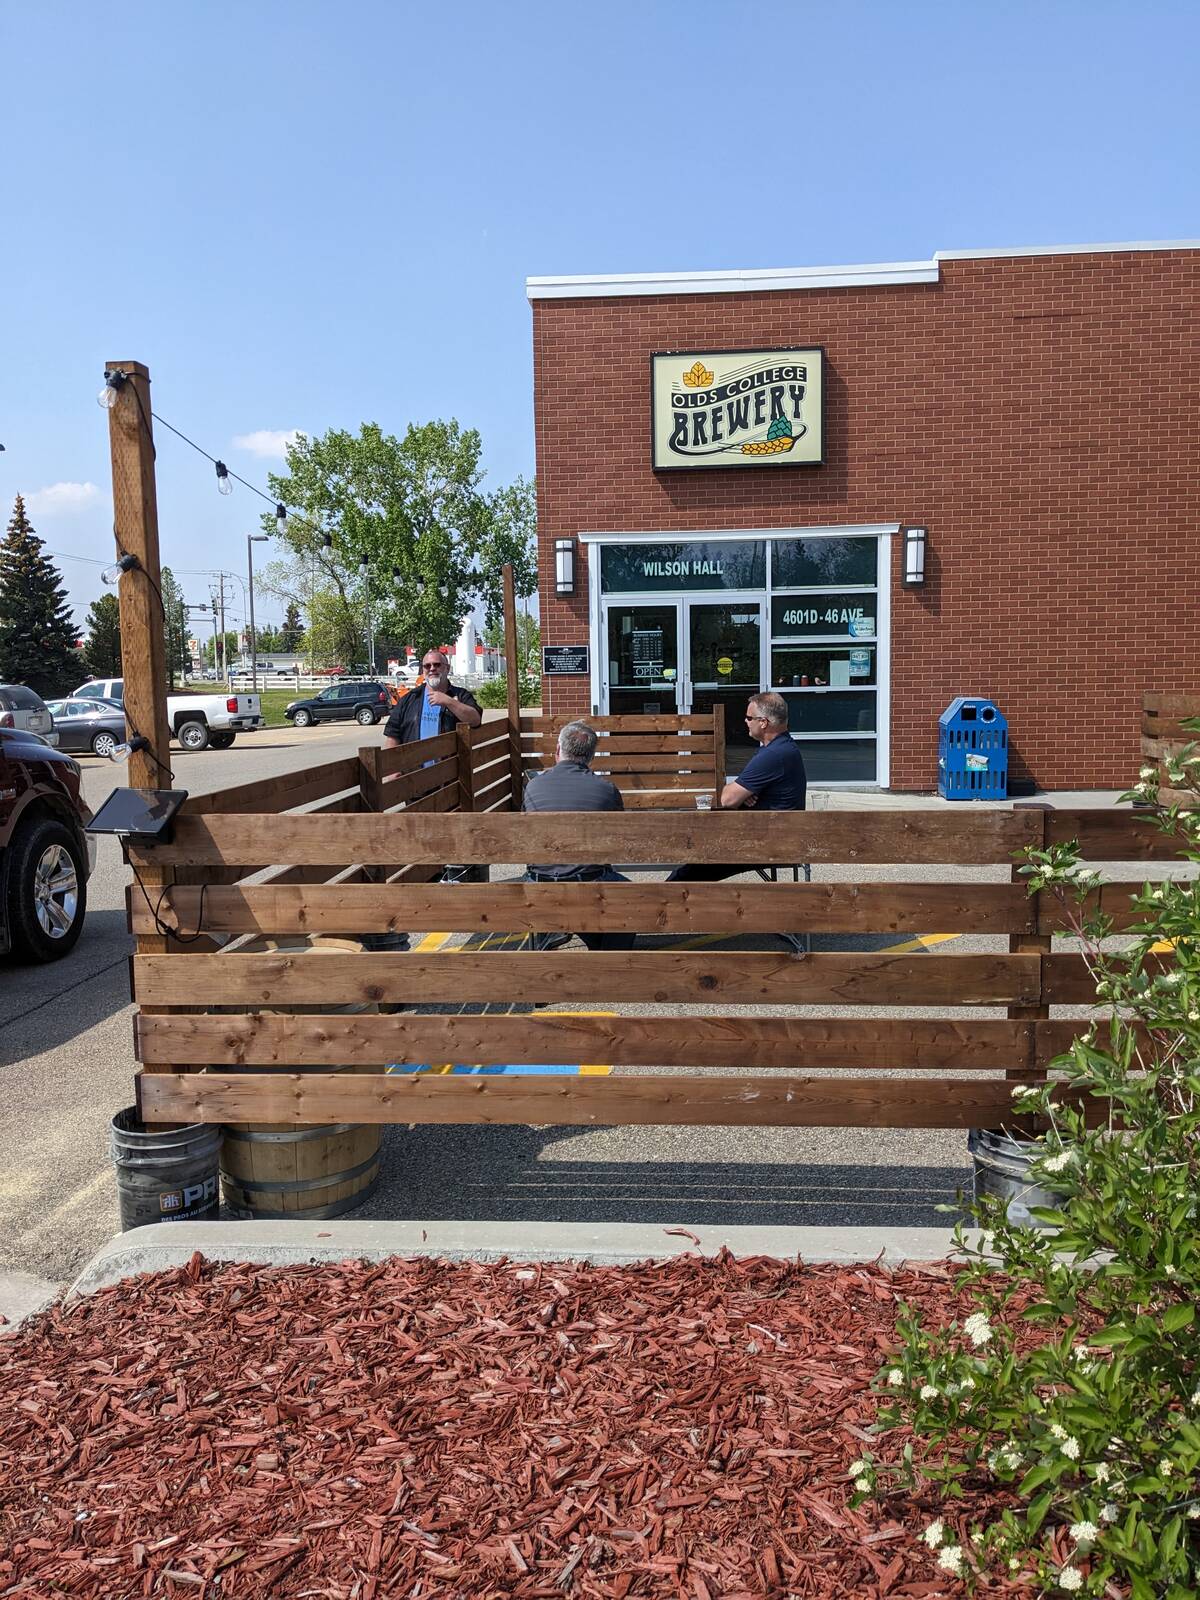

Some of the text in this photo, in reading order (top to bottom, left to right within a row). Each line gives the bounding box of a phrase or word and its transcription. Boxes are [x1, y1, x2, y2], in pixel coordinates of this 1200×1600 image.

[672, 366, 805, 408] OLDS COLLEGE
[671, 384, 806, 448] BREWERY
[643, 560, 724, 577] WILSON HALL
[782, 609, 819, 625] 4601D
[824, 608, 839, 624] 46
[839, 608, 864, 624] AVE
[635, 668, 661, 676] OPEN
